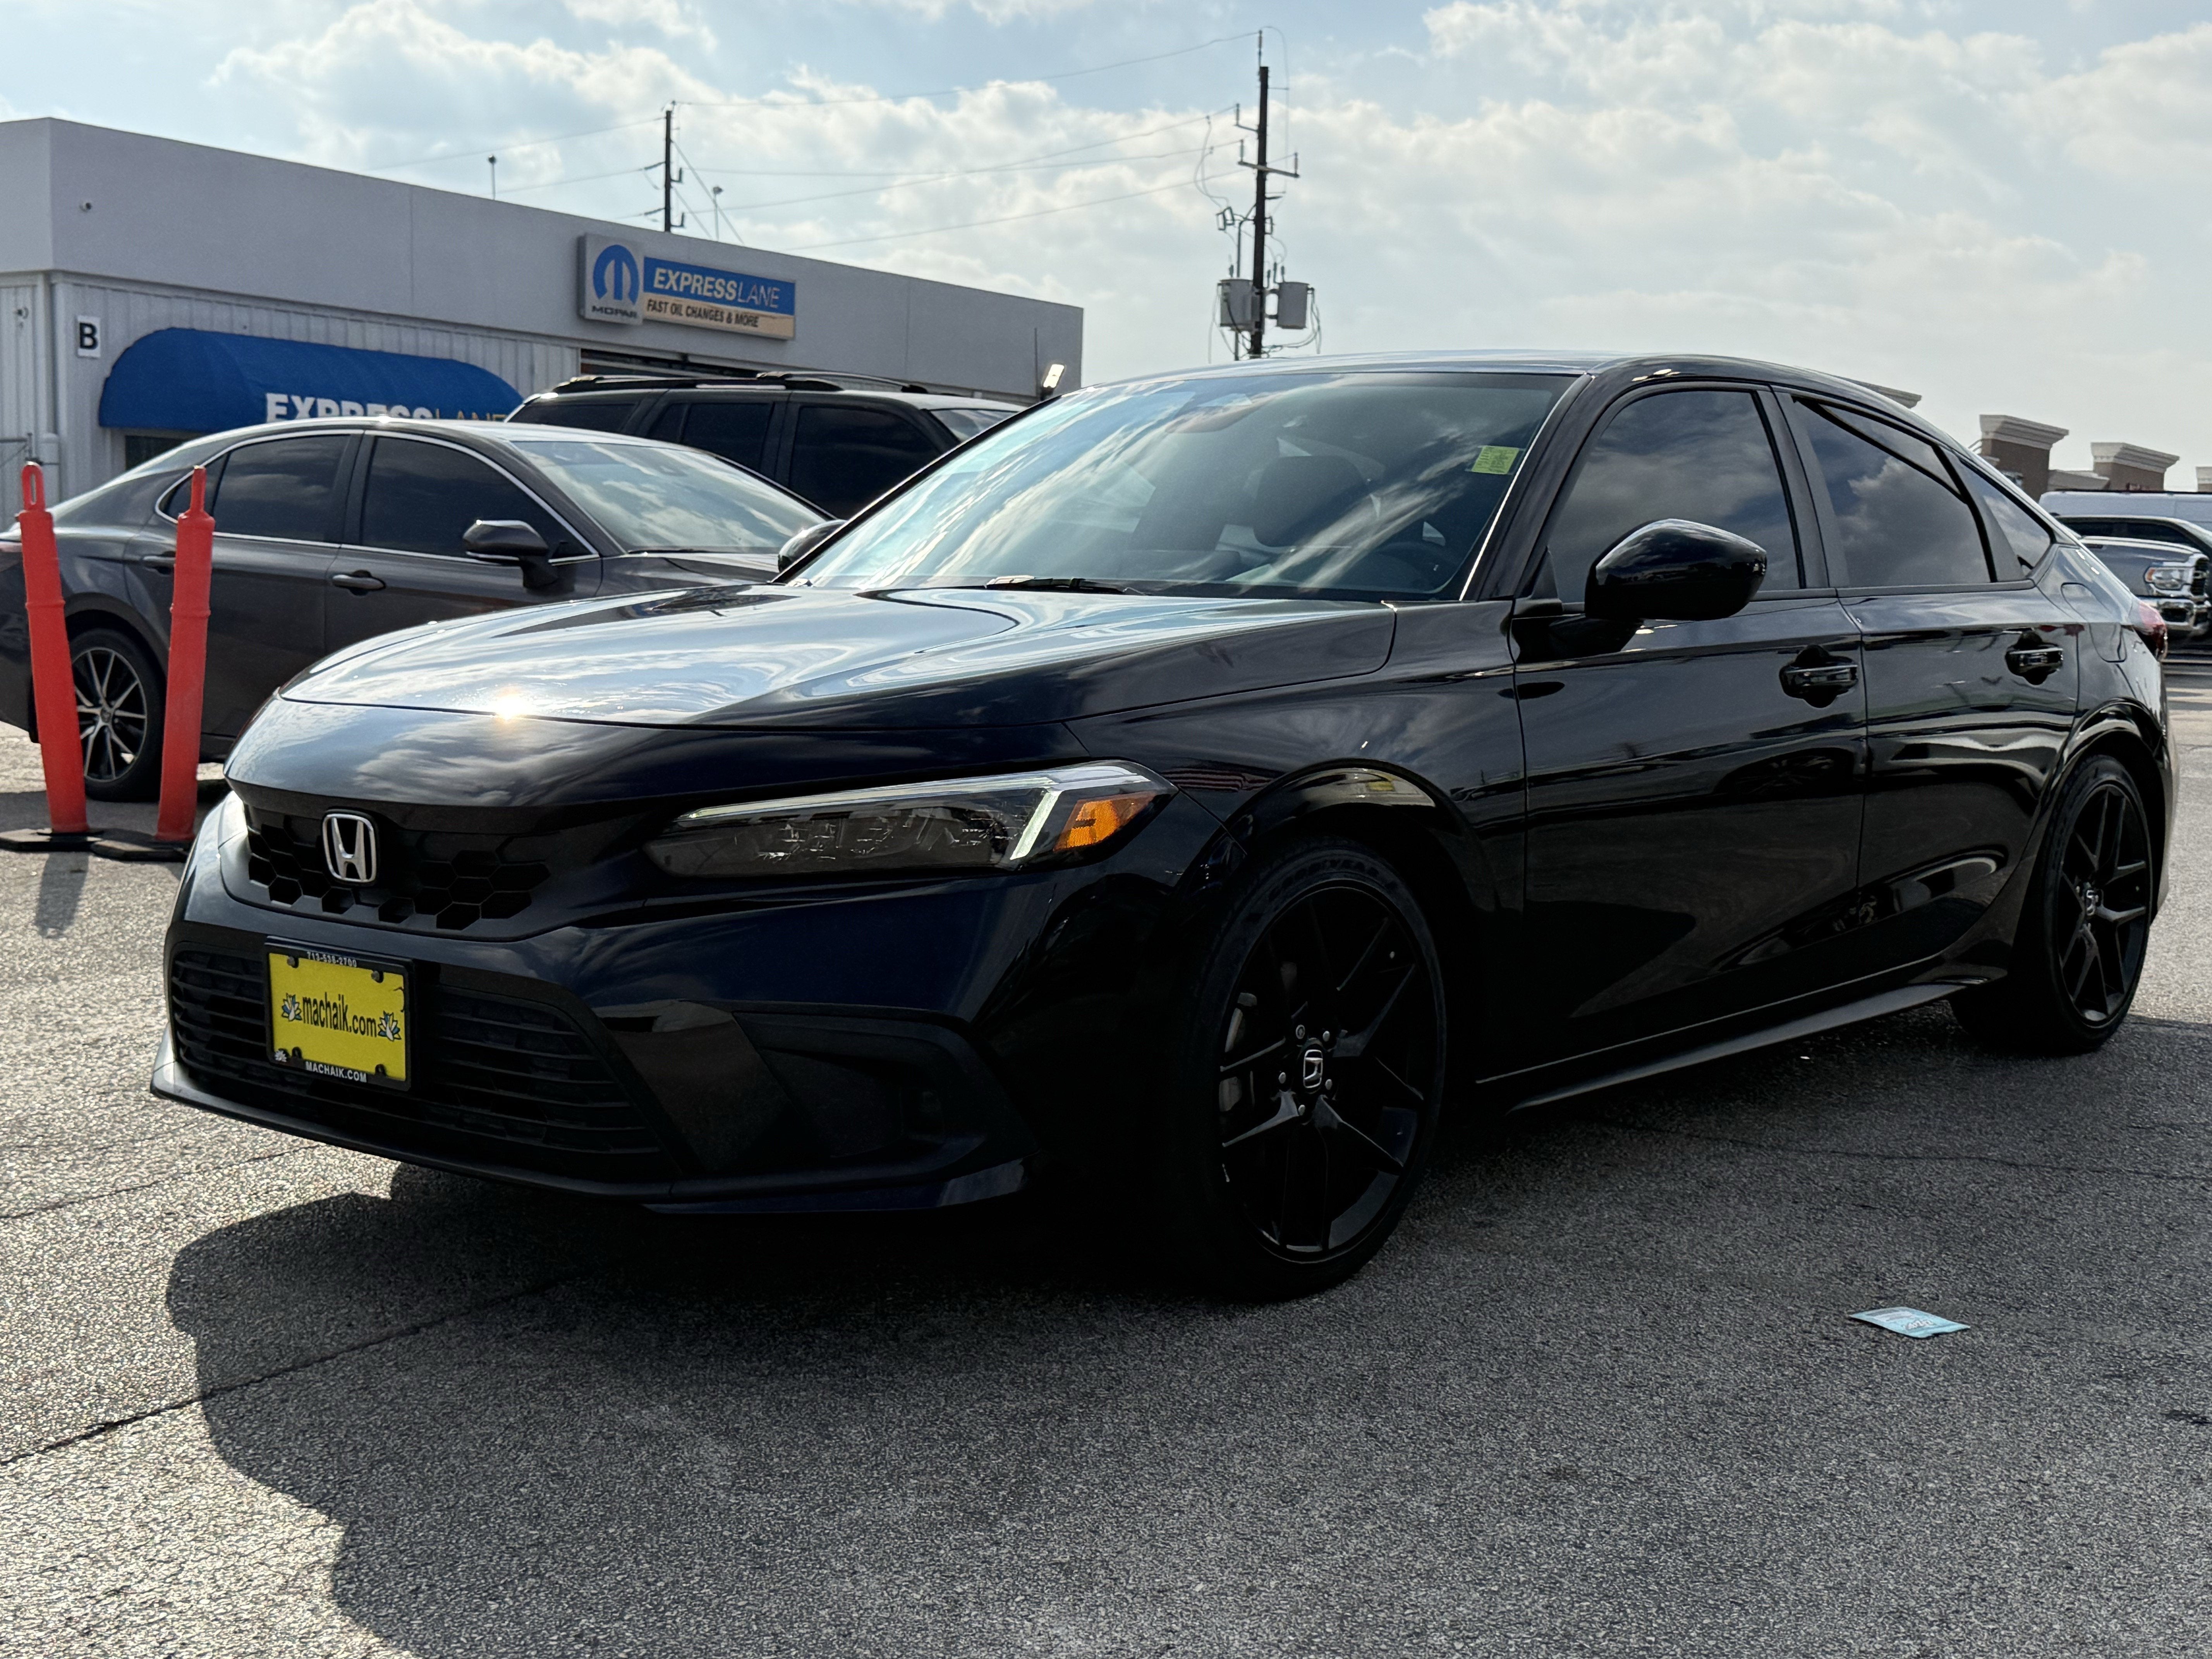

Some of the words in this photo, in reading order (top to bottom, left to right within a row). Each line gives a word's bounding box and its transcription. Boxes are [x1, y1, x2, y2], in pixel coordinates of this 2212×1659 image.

[647, 299, 669, 313] FAST
[670, 303, 683, 316] OIL
[686, 306, 724, 322] CHANGES
[726, 312, 733, 324] &
[735, 313, 759, 328] MORE
[79, 322, 98, 350] B
[302, 991, 377, 1037] machaik.com
[306, 1061, 367, 1083] MACHAIK.COM
